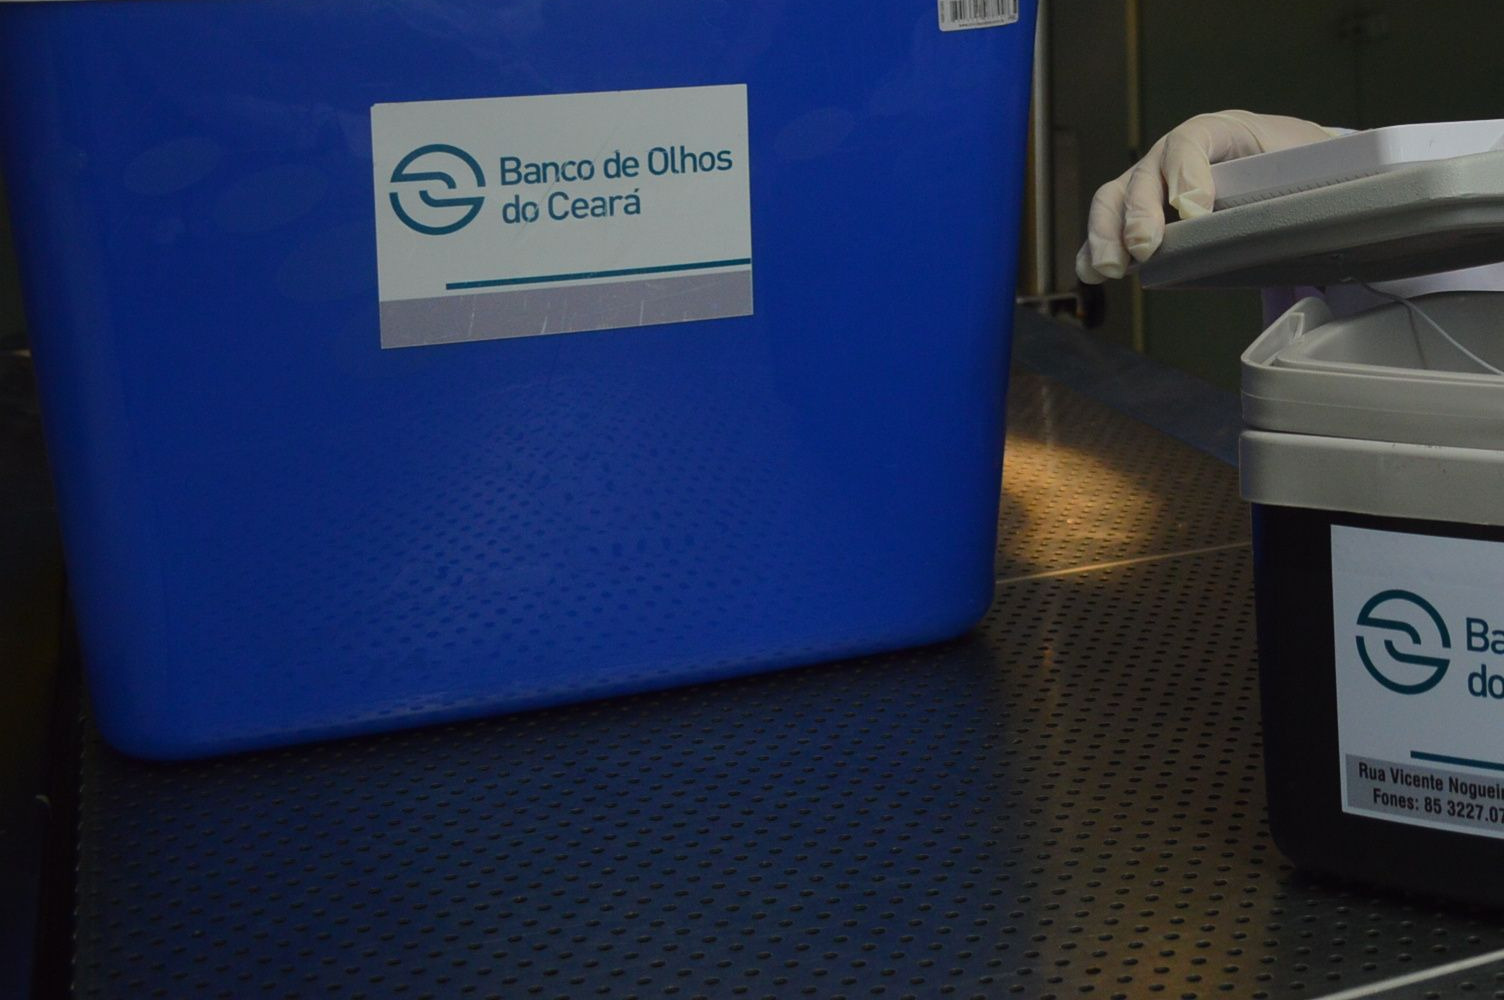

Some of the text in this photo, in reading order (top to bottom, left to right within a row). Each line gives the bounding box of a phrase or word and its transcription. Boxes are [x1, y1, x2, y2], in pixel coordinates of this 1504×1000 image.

[500, 145, 733, 186] Banco de Olhos
[502, 188, 641, 224] do Ceará
[1358, 762, 1386, 782] Rua
[1390, 766, 1444, 791] Vicente
[1373, 788, 1420, 811] Fones:
[1424, 796, 1442, 814] 85
